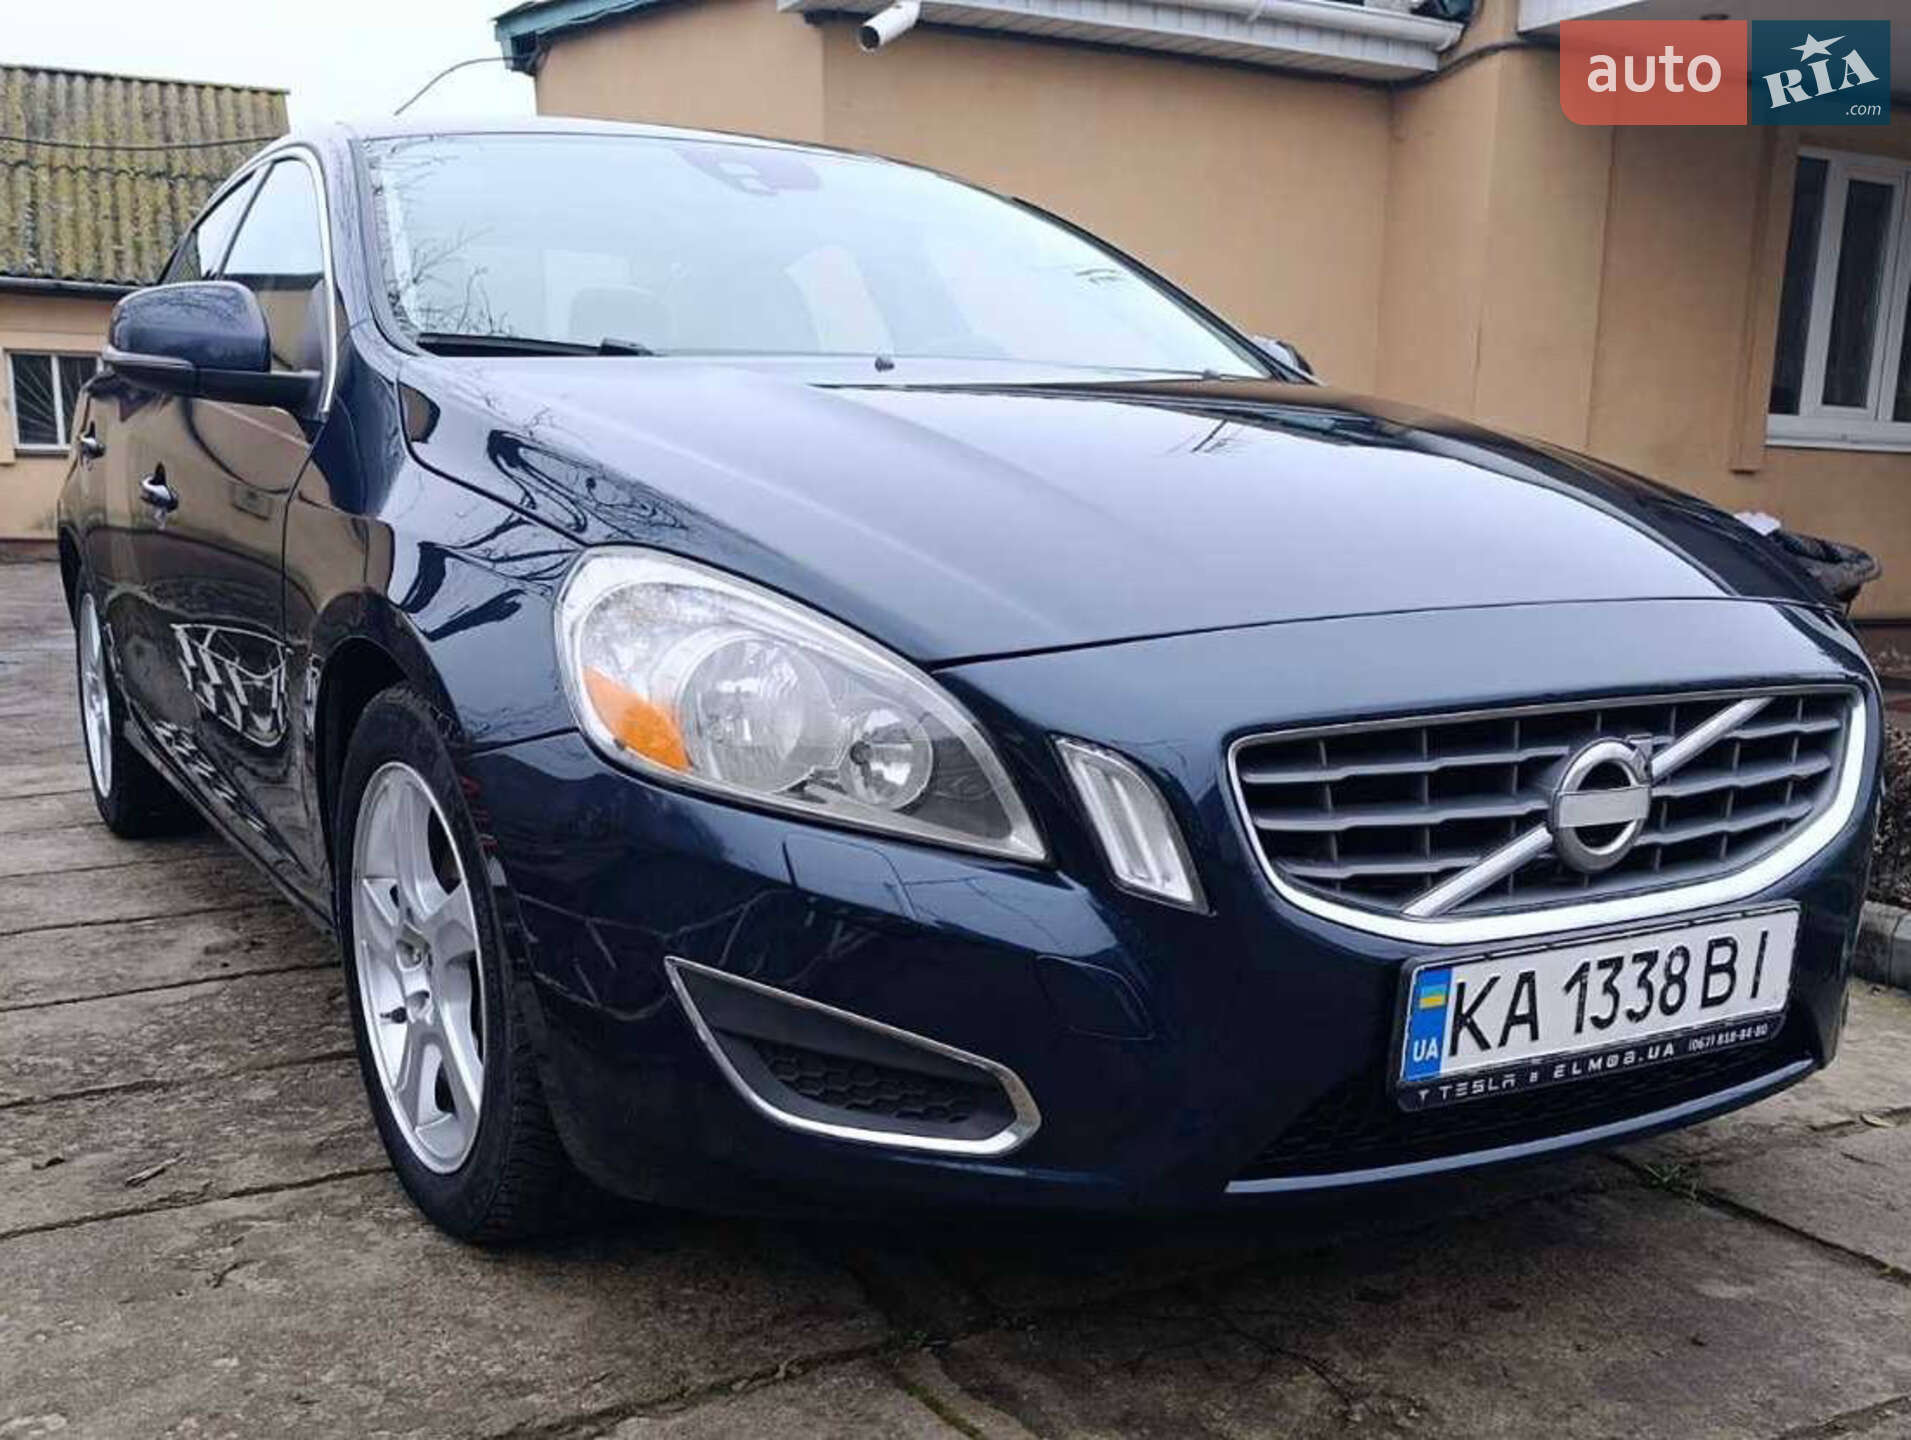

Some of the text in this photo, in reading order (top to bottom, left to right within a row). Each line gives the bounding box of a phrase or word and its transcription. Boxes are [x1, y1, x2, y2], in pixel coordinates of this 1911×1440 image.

[1448, 929, 1769, 1057] KA 1338 BI
[1412, 1036, 1439, 1063] UA
[1438, 1073, 1516, 1100] TESLA
